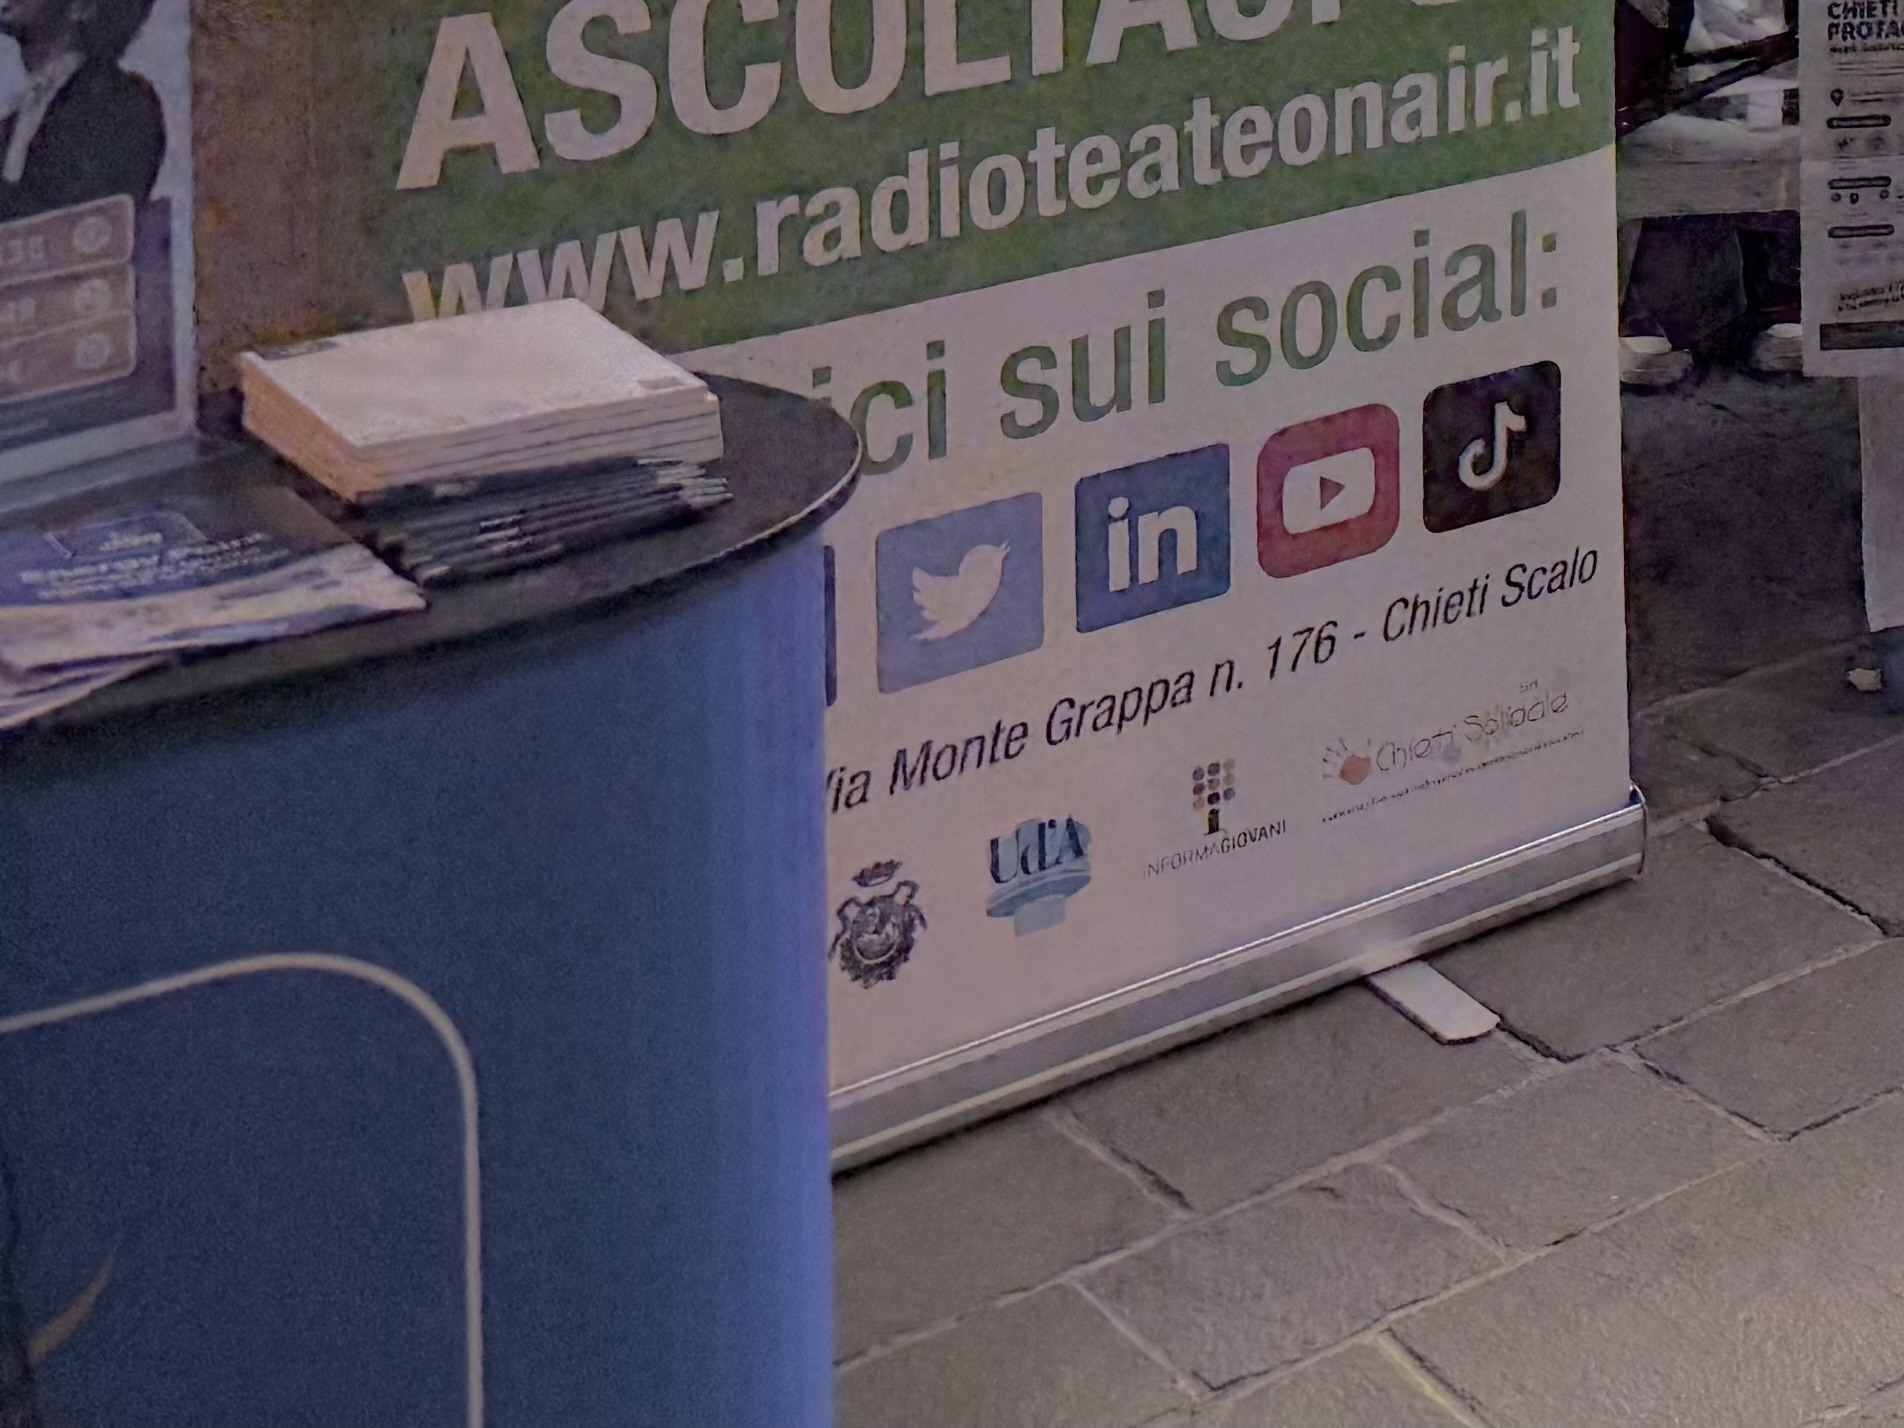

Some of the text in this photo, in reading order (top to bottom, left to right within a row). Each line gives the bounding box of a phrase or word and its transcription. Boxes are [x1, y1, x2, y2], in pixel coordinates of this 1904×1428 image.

[1000, 209, 1559, 442] sui social:
[891, 544, 1598, 792] Monte Grappa n. 176 Chieti Scalo
